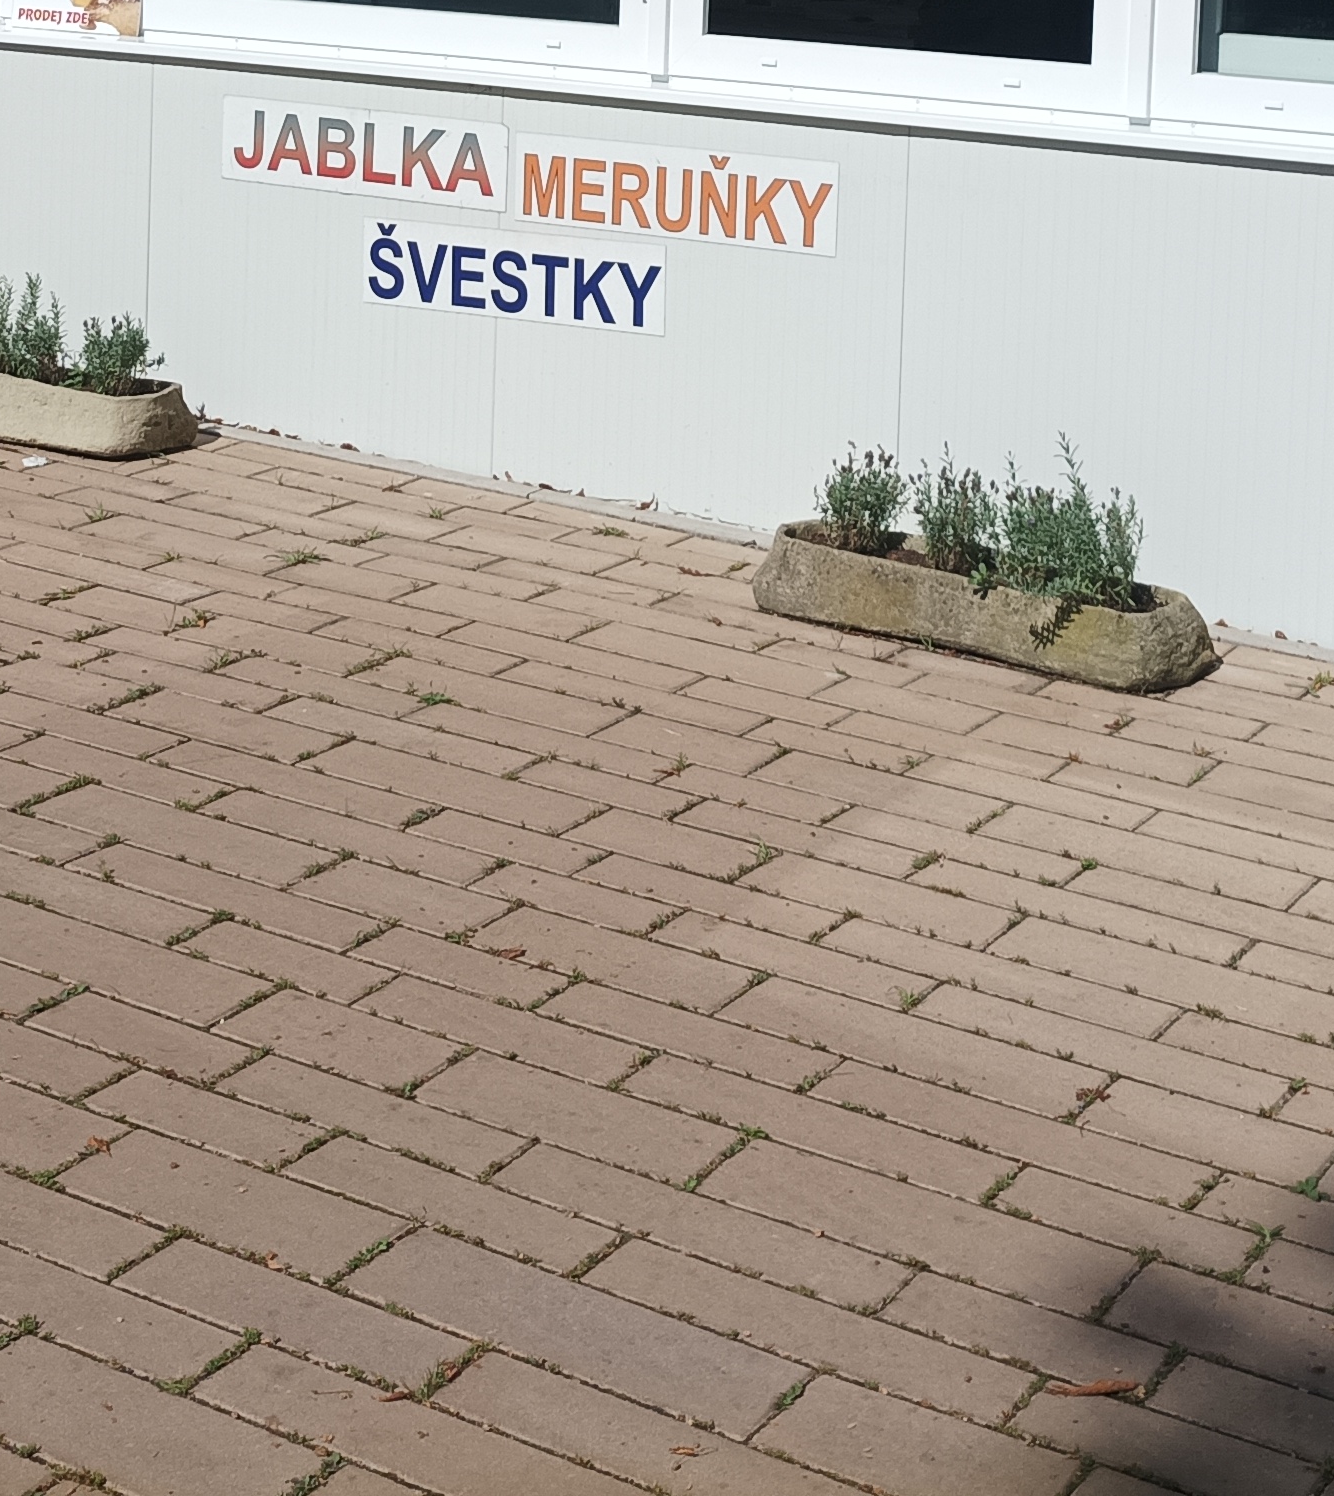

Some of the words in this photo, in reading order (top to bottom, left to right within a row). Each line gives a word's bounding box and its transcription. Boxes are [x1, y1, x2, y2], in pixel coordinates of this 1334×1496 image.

[18, 7, 62, 25] PRODEJ
[65, 11, 89, 25] ZDE
[233, 109, 495, 197] JABLKA
[522, 154, 834, 249] MERUŇKY
[367, 222, 663, 328] ŠVESTKY
